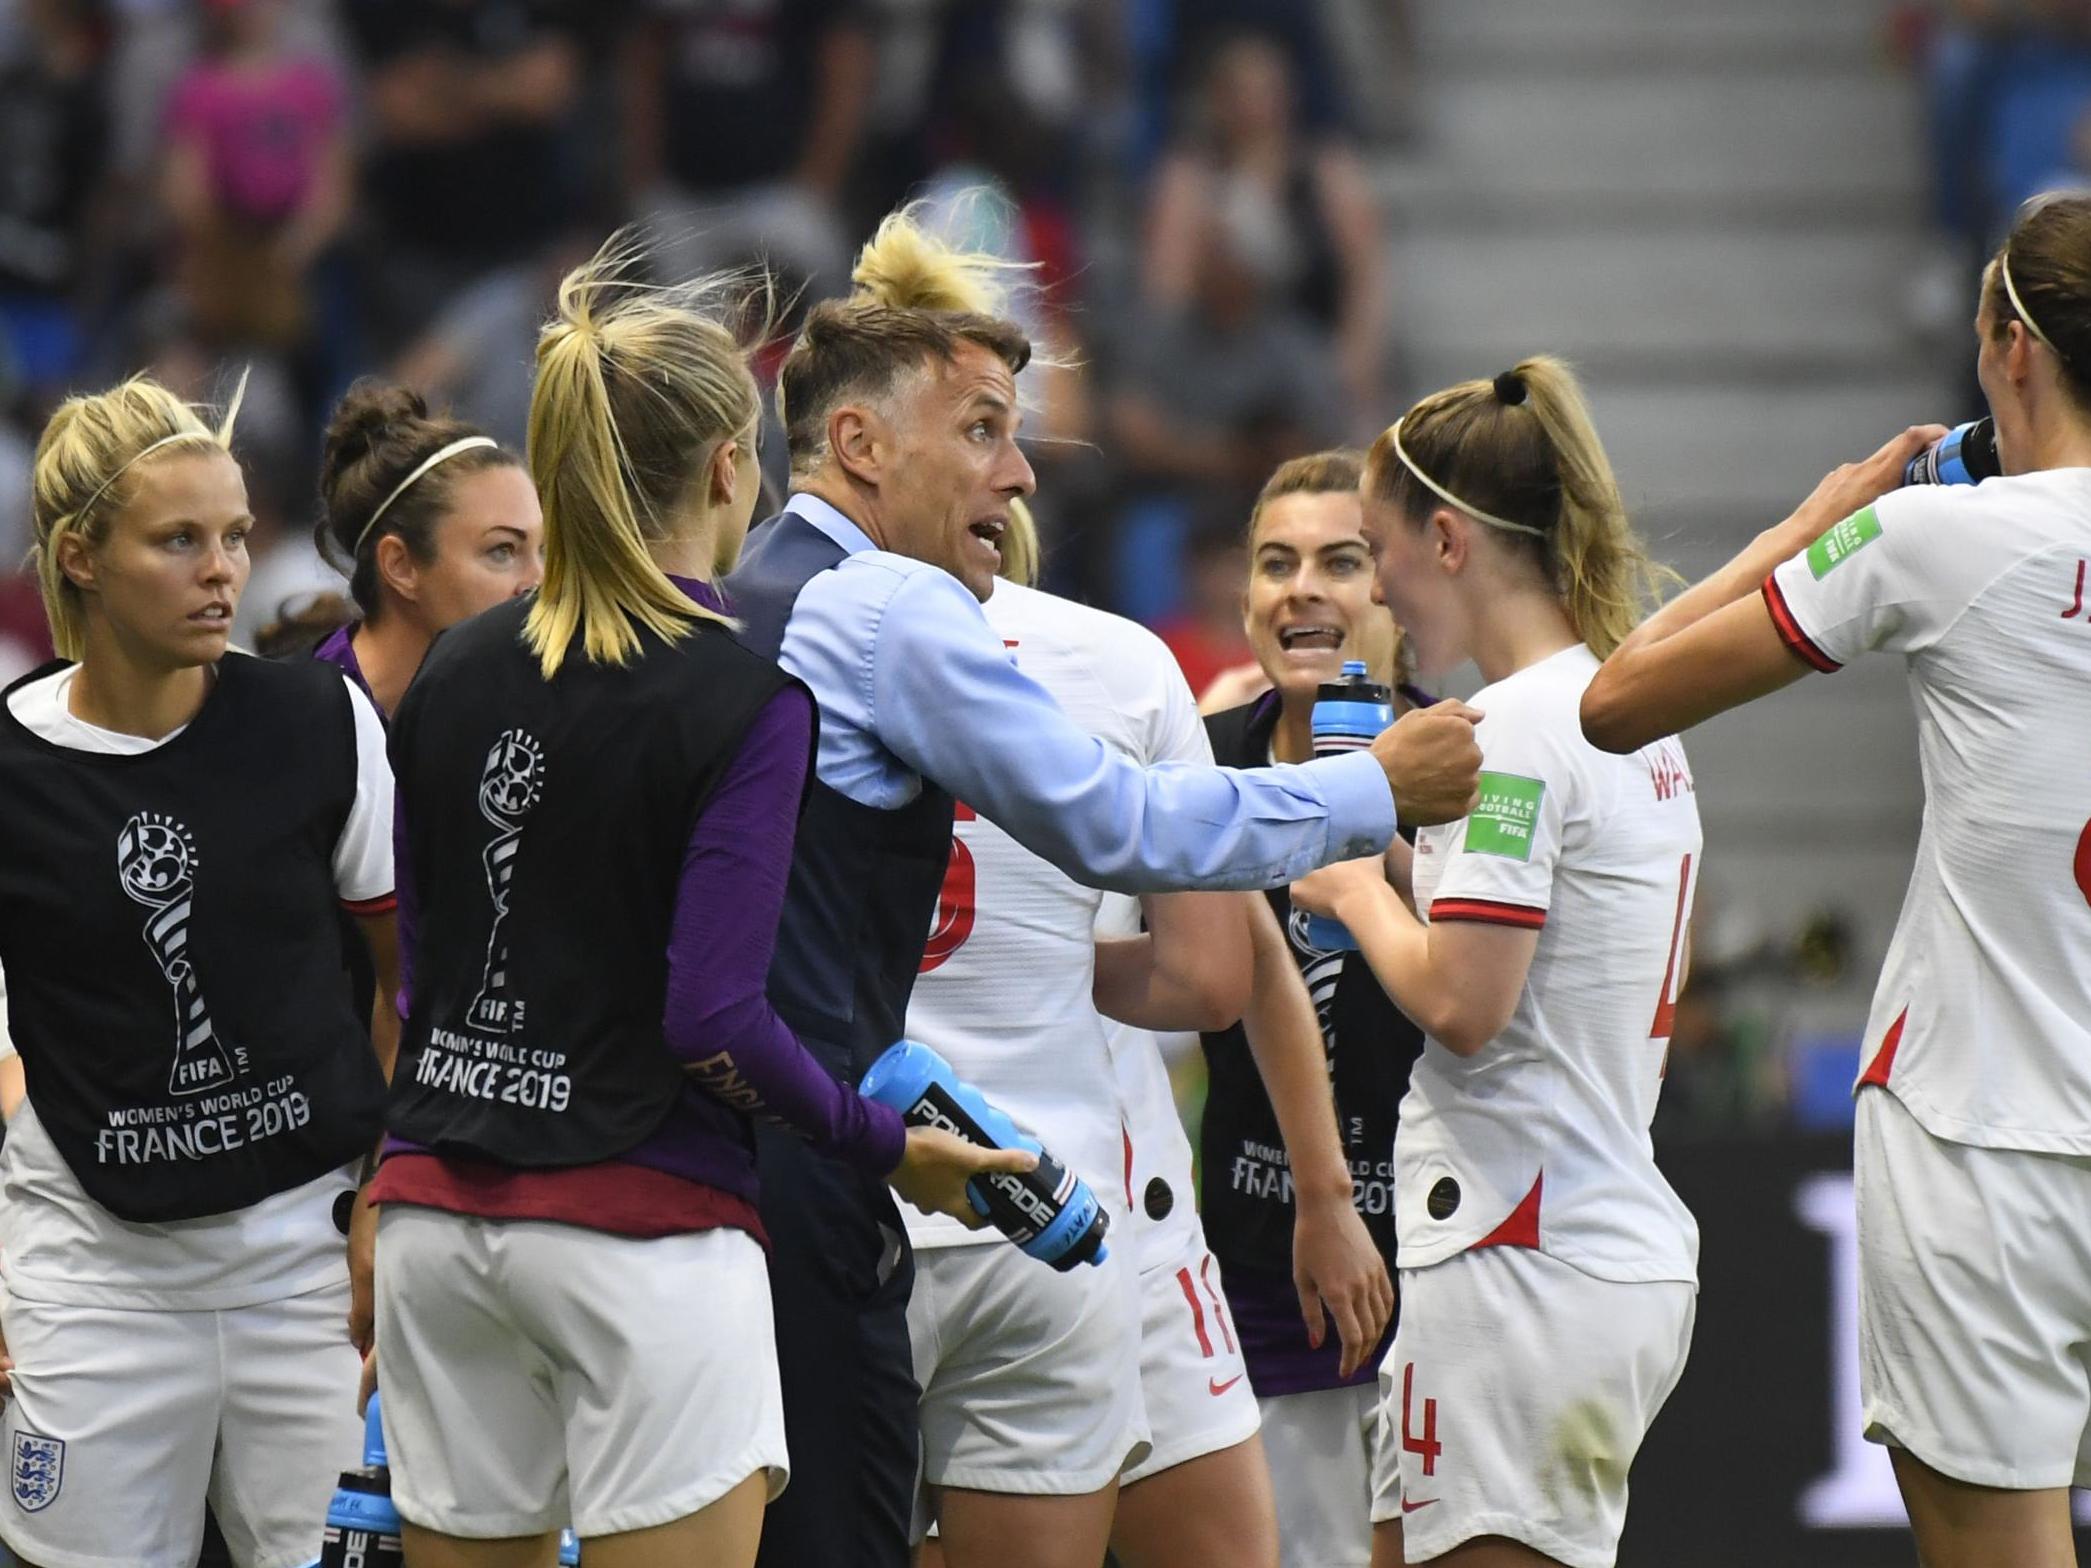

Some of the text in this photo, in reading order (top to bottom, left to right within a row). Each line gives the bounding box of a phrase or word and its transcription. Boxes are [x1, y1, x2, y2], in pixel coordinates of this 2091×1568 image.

[1644, 750, 1695, 801] WA
[1478, 803, 1532, 819] OOTBALL
[1483, 794, 1535, 810] IVING
[1499, 822, 1528, 839] FIFA
[179, 1057, 224, 1085] FIFA
[531, 1050, 566, 1069] CUP
[108, 1075, 294, 1127] WOMEN'S WORLD CUP
[501, 1067, 571, 1112] 2019
[94, 1092, 311, 1164] FRANCE 2019
[1231, 1157, 1396, 1216] FRAN 201
[1402, 1362, 1442, 1476] 4
